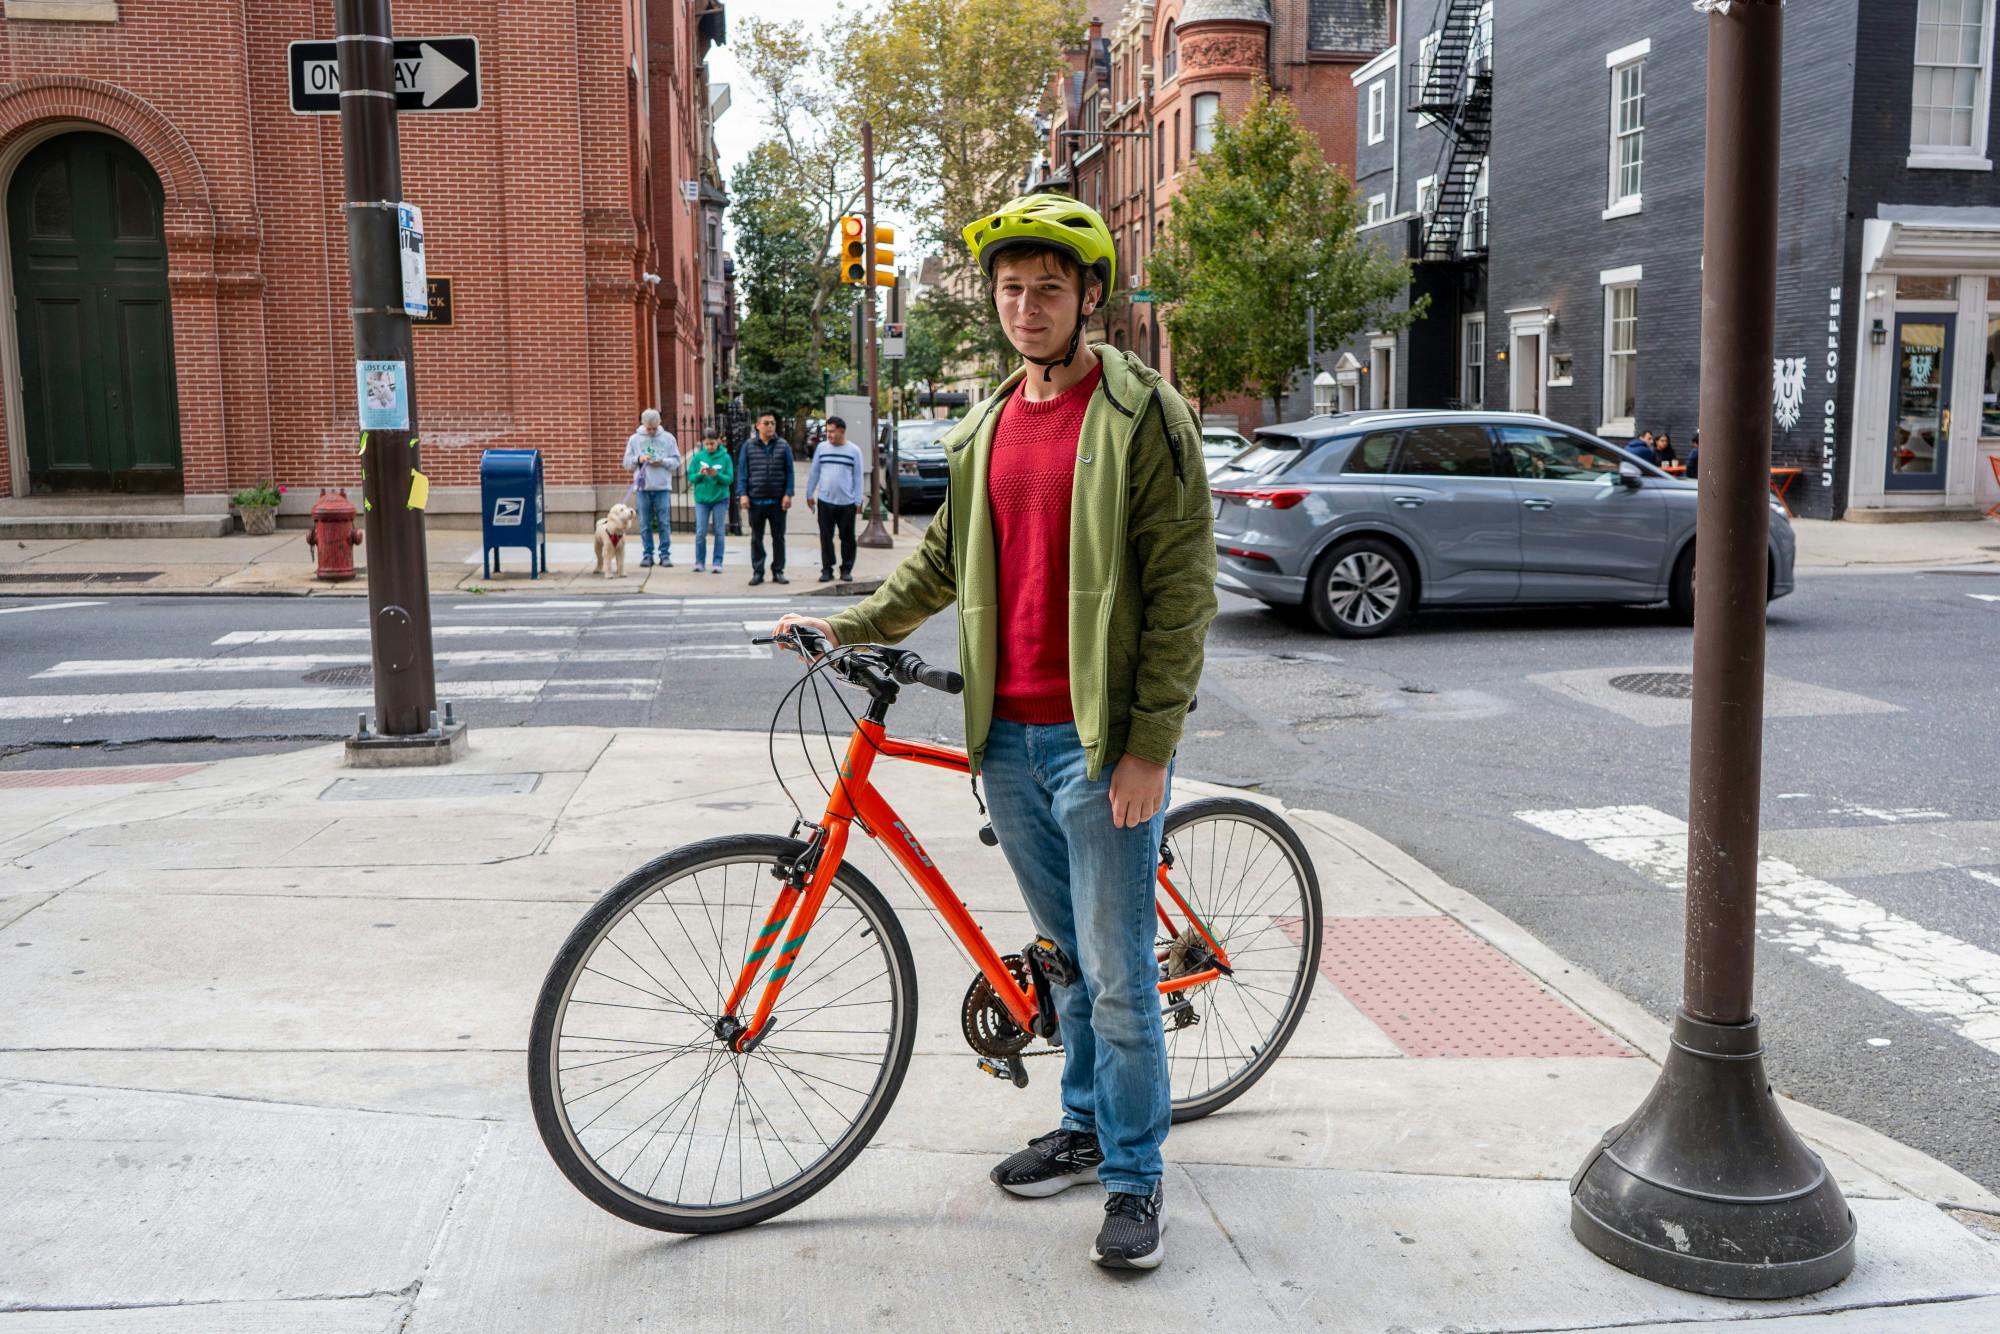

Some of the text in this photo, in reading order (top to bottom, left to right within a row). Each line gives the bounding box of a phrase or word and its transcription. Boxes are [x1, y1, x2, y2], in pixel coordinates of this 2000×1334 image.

[311, 62, 421, 90] ON AY
[401, 230, 411, 250] 17
[1905, 345, 1938, 353] ULTIMO
[1783, 382, 1793, 399] U
[1822, 286, 1841, 487] ULTIMO COFFEE
[893, 820, 934, 868] FUJI
